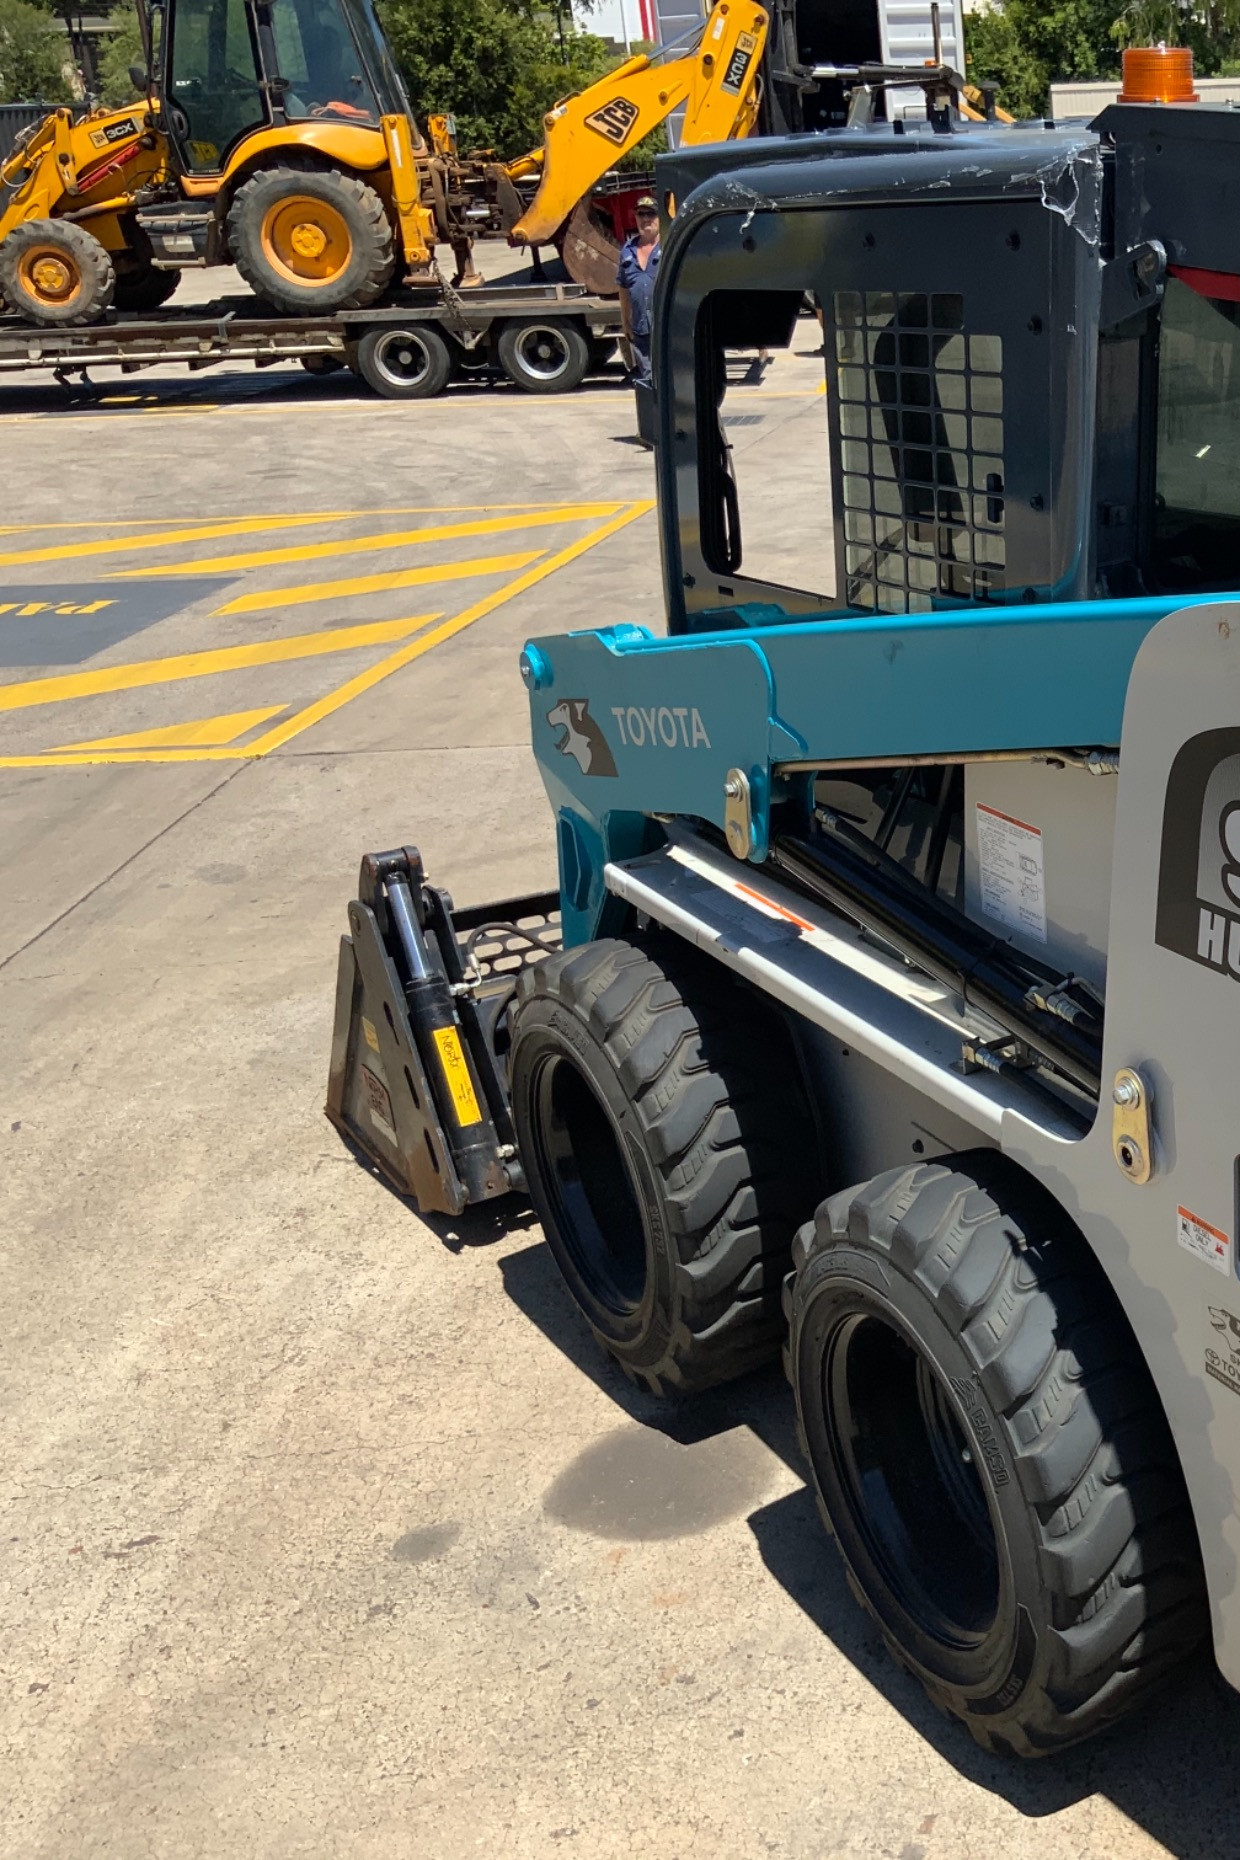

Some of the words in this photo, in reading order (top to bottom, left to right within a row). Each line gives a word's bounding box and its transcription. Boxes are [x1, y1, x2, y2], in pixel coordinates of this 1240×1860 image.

[727, 52, 748, 85] 3CX
[106, 122, 134, 139] 3CX
[593, 100, 636, 140] JCB
[611, 706, 711, 748] TOYOTA
